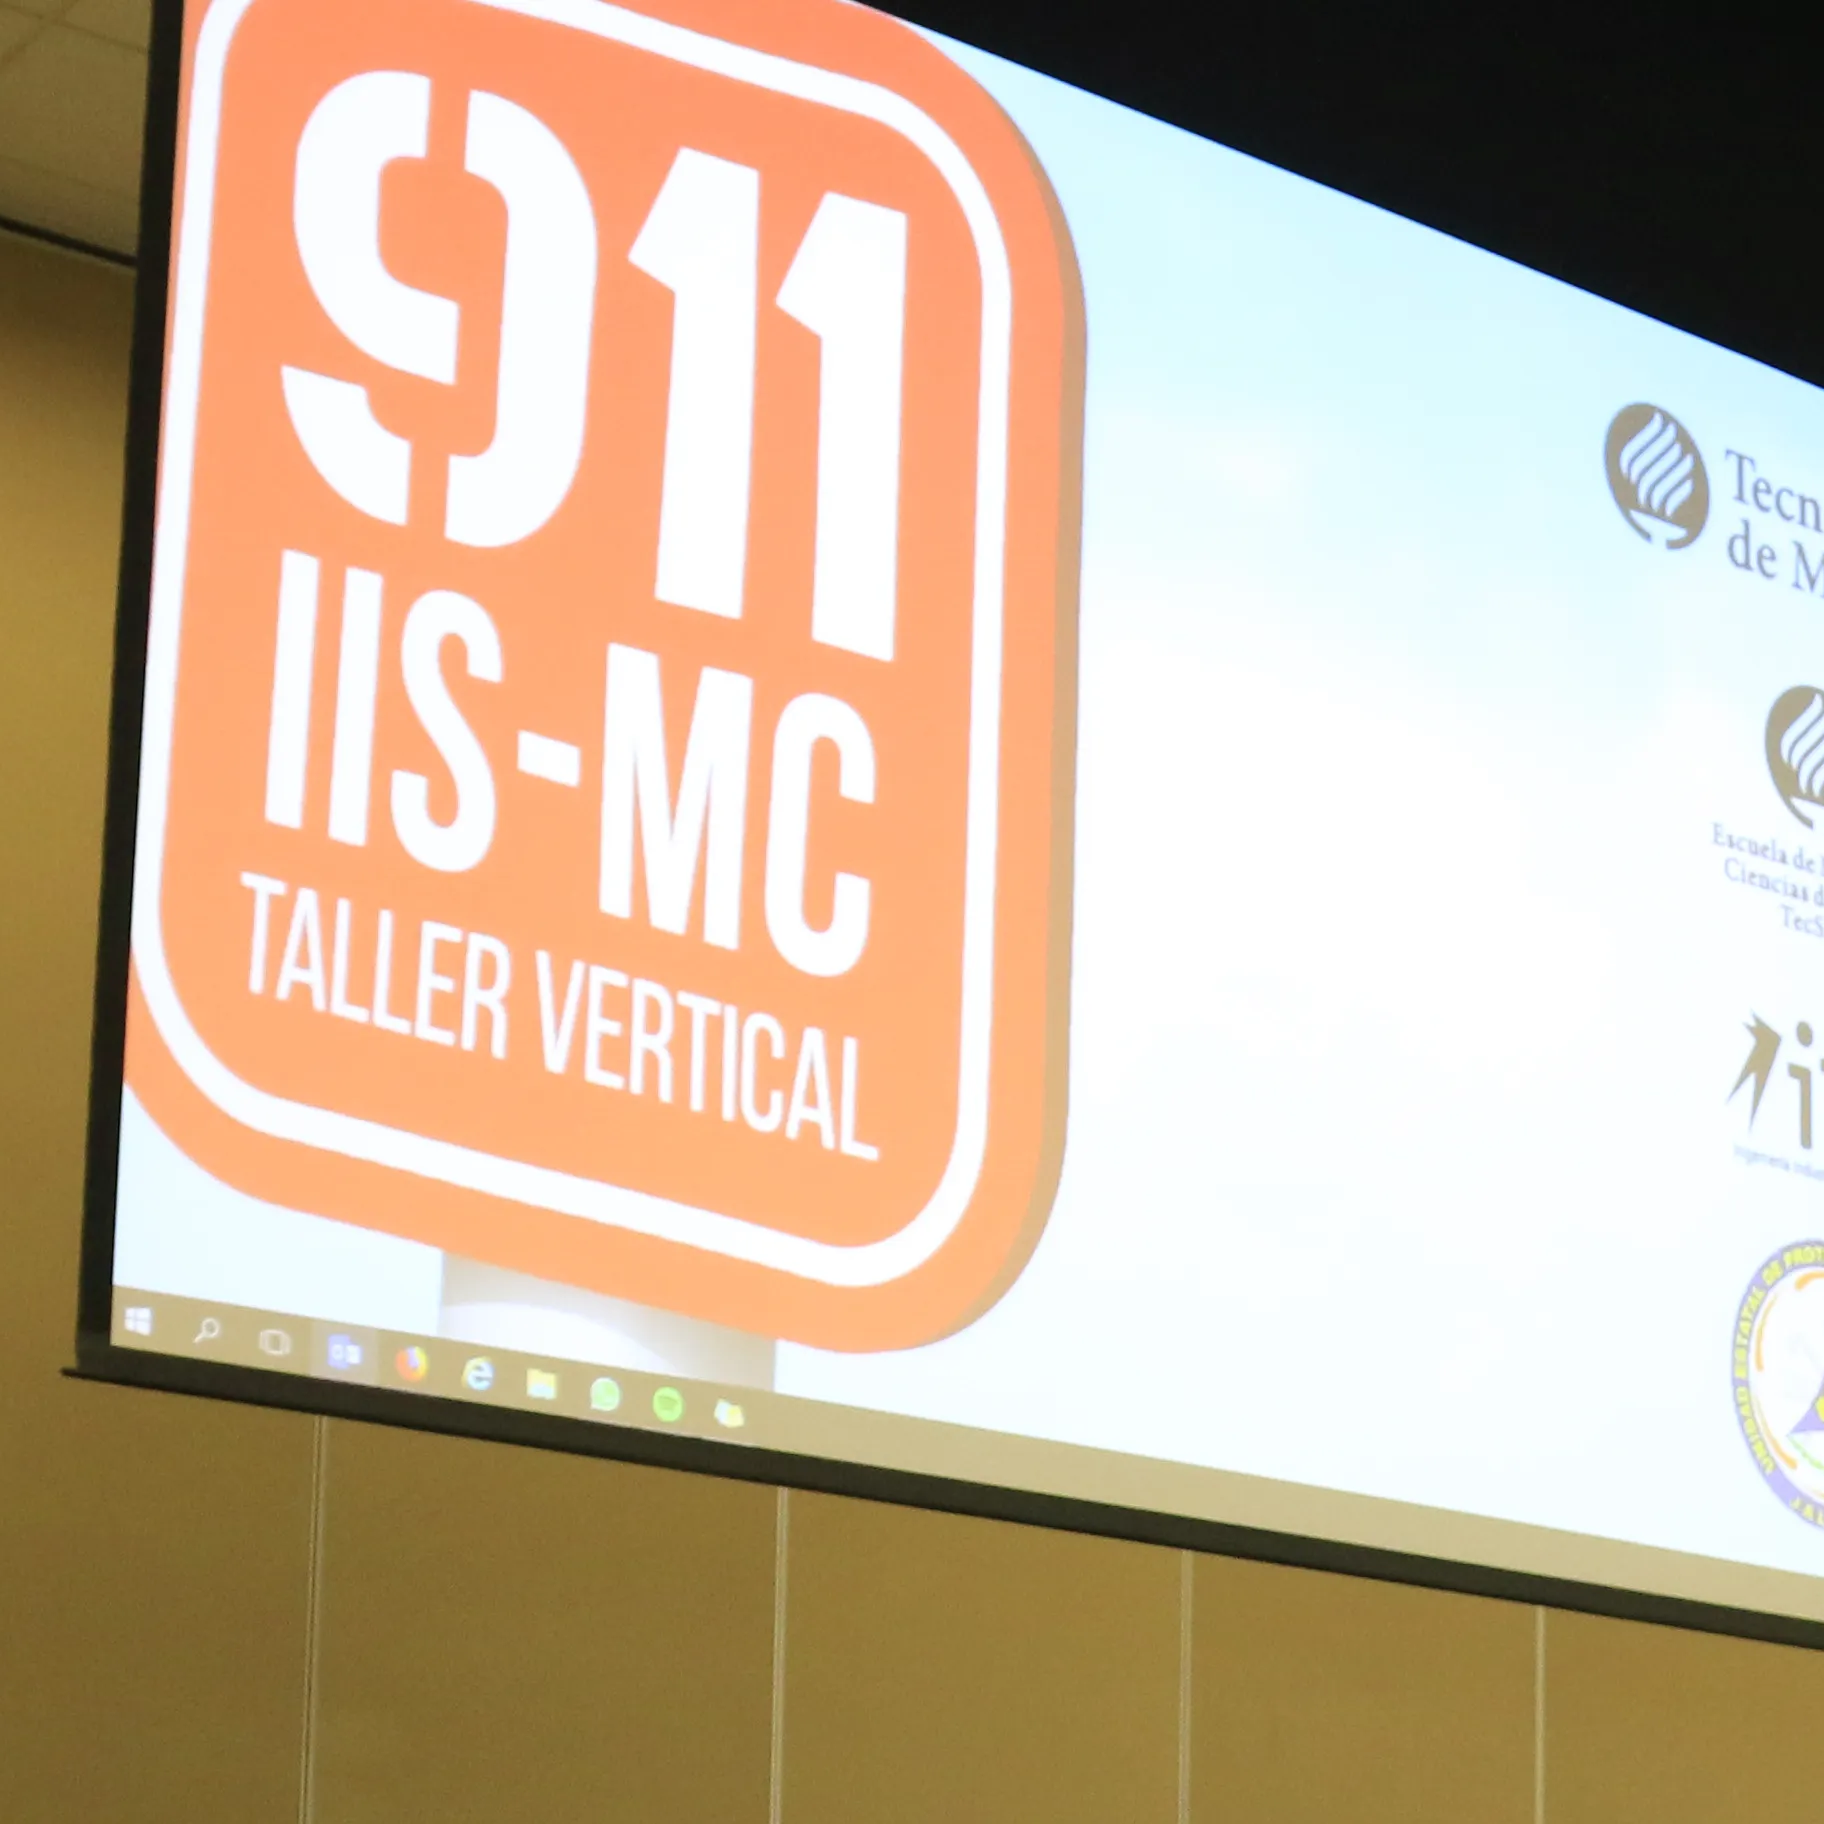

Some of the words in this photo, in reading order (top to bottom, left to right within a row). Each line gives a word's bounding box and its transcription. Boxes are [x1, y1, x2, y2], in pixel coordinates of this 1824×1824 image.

[280, 70, 907, 662] 911
[1727, 519, 1776, 580] de
[264, 549, 877, 977] IIS-MC
[1711, 822, 1788, 865] Escuela
[1792, 847, 1815, 874] de
[1724, 857, 1809, 903] Ciencias
[241, 872, 511, 1059] TALLER
[535, 949, 879, 1161] VERTICAL
